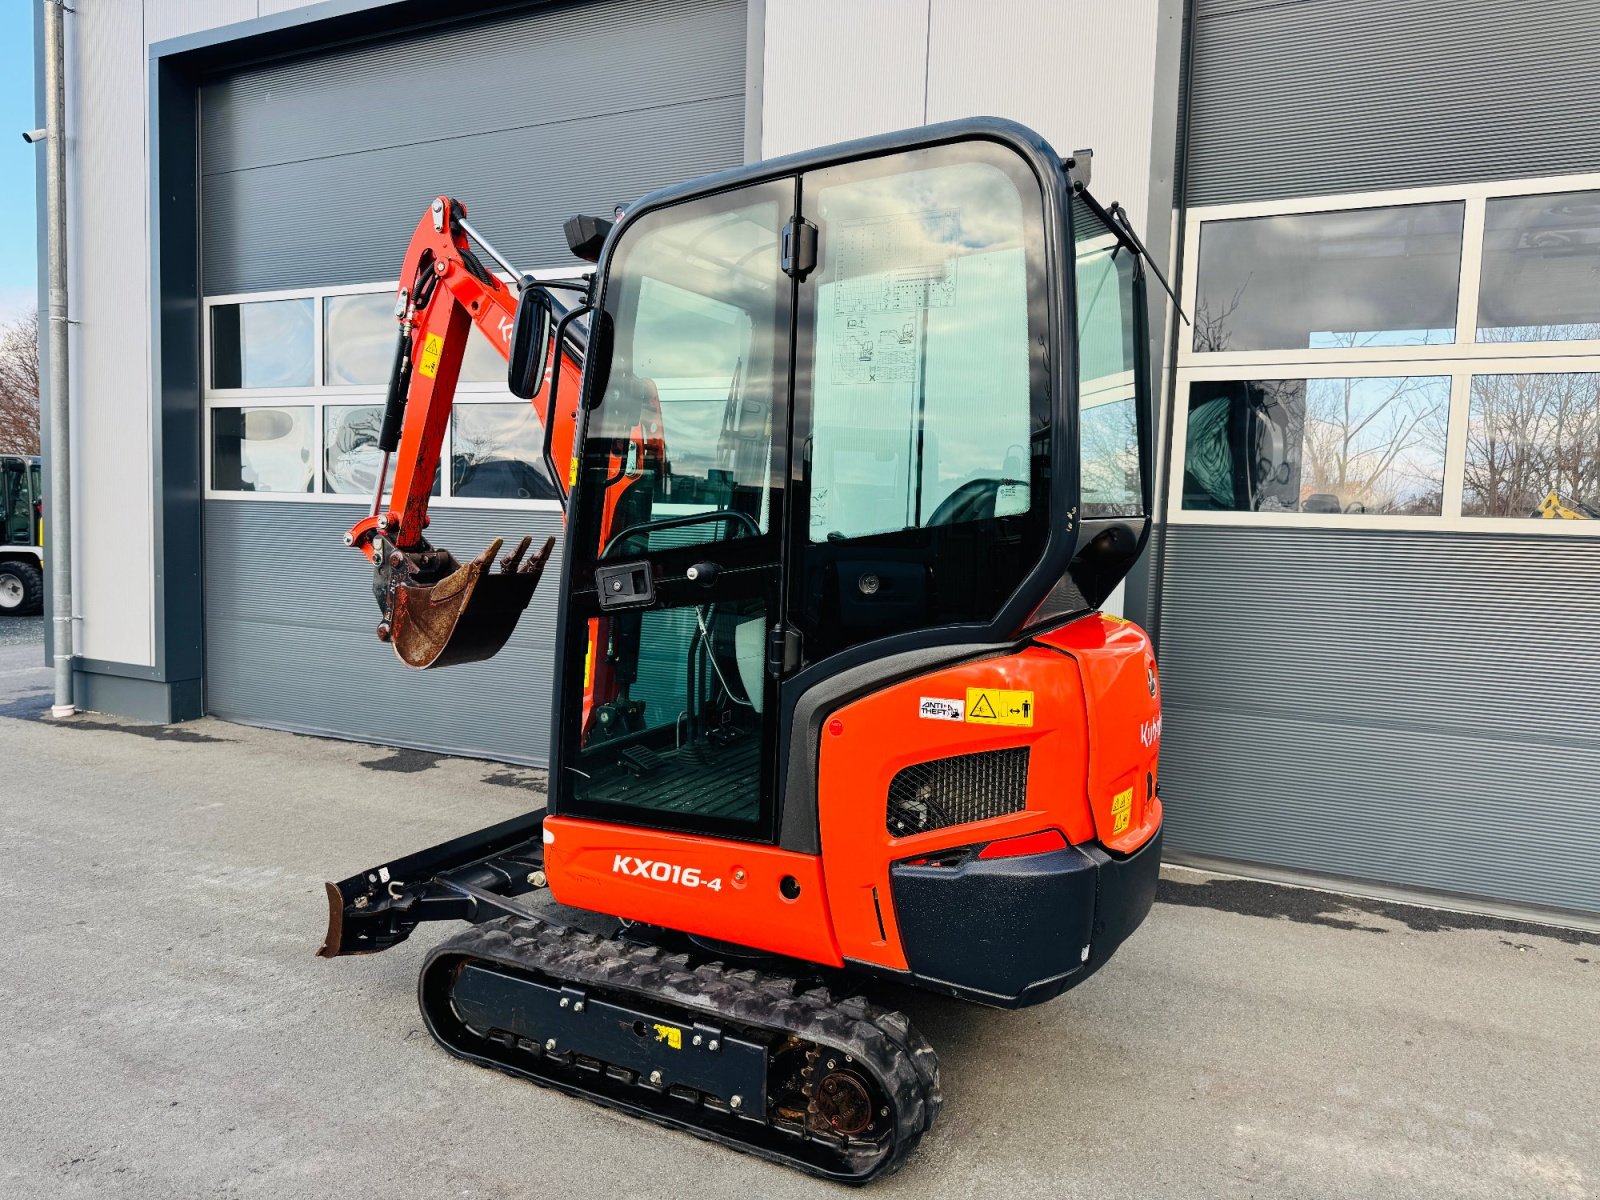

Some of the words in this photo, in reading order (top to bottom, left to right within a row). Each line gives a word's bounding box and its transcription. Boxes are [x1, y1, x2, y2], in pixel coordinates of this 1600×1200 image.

[922, 701, 943, 709] ANTI
[920, 707, 947, 715] THEFT
[612, 854, 723, 892] KX016-4
